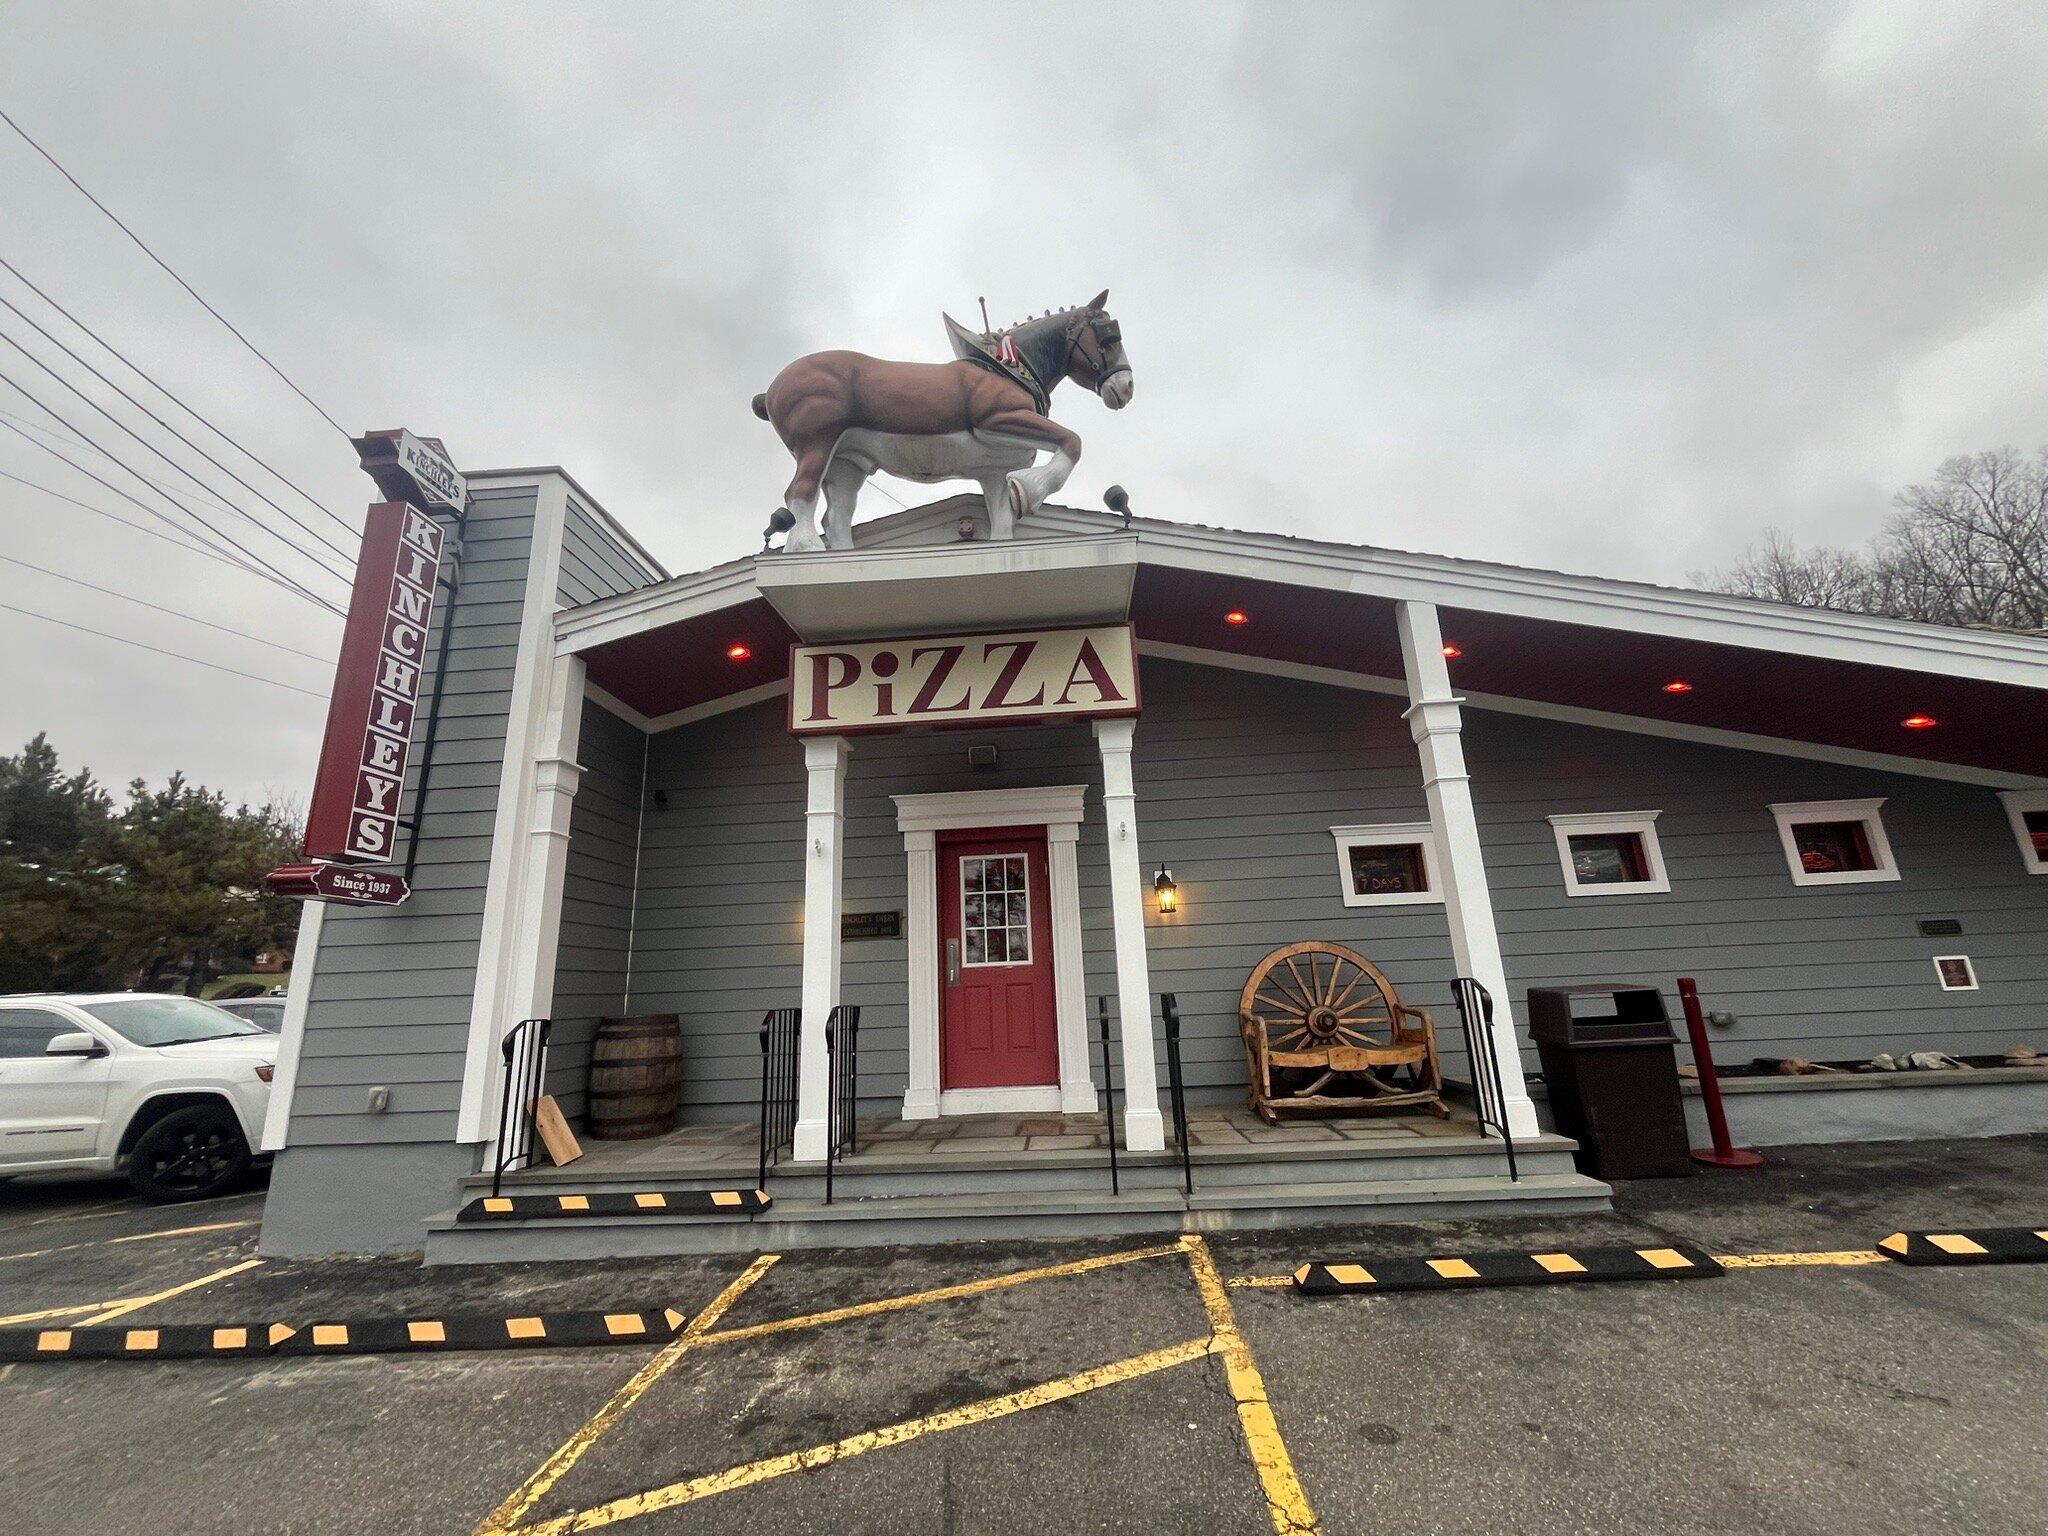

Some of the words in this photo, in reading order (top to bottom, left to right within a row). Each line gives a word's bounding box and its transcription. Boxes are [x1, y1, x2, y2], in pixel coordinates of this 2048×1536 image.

[356, 511, 438, 852] KINCHLEYS
[332, 875, 366, 891] Since
[367, 881, 391, 895] 1937
[1372, 877, 1401, 889] DAYS
